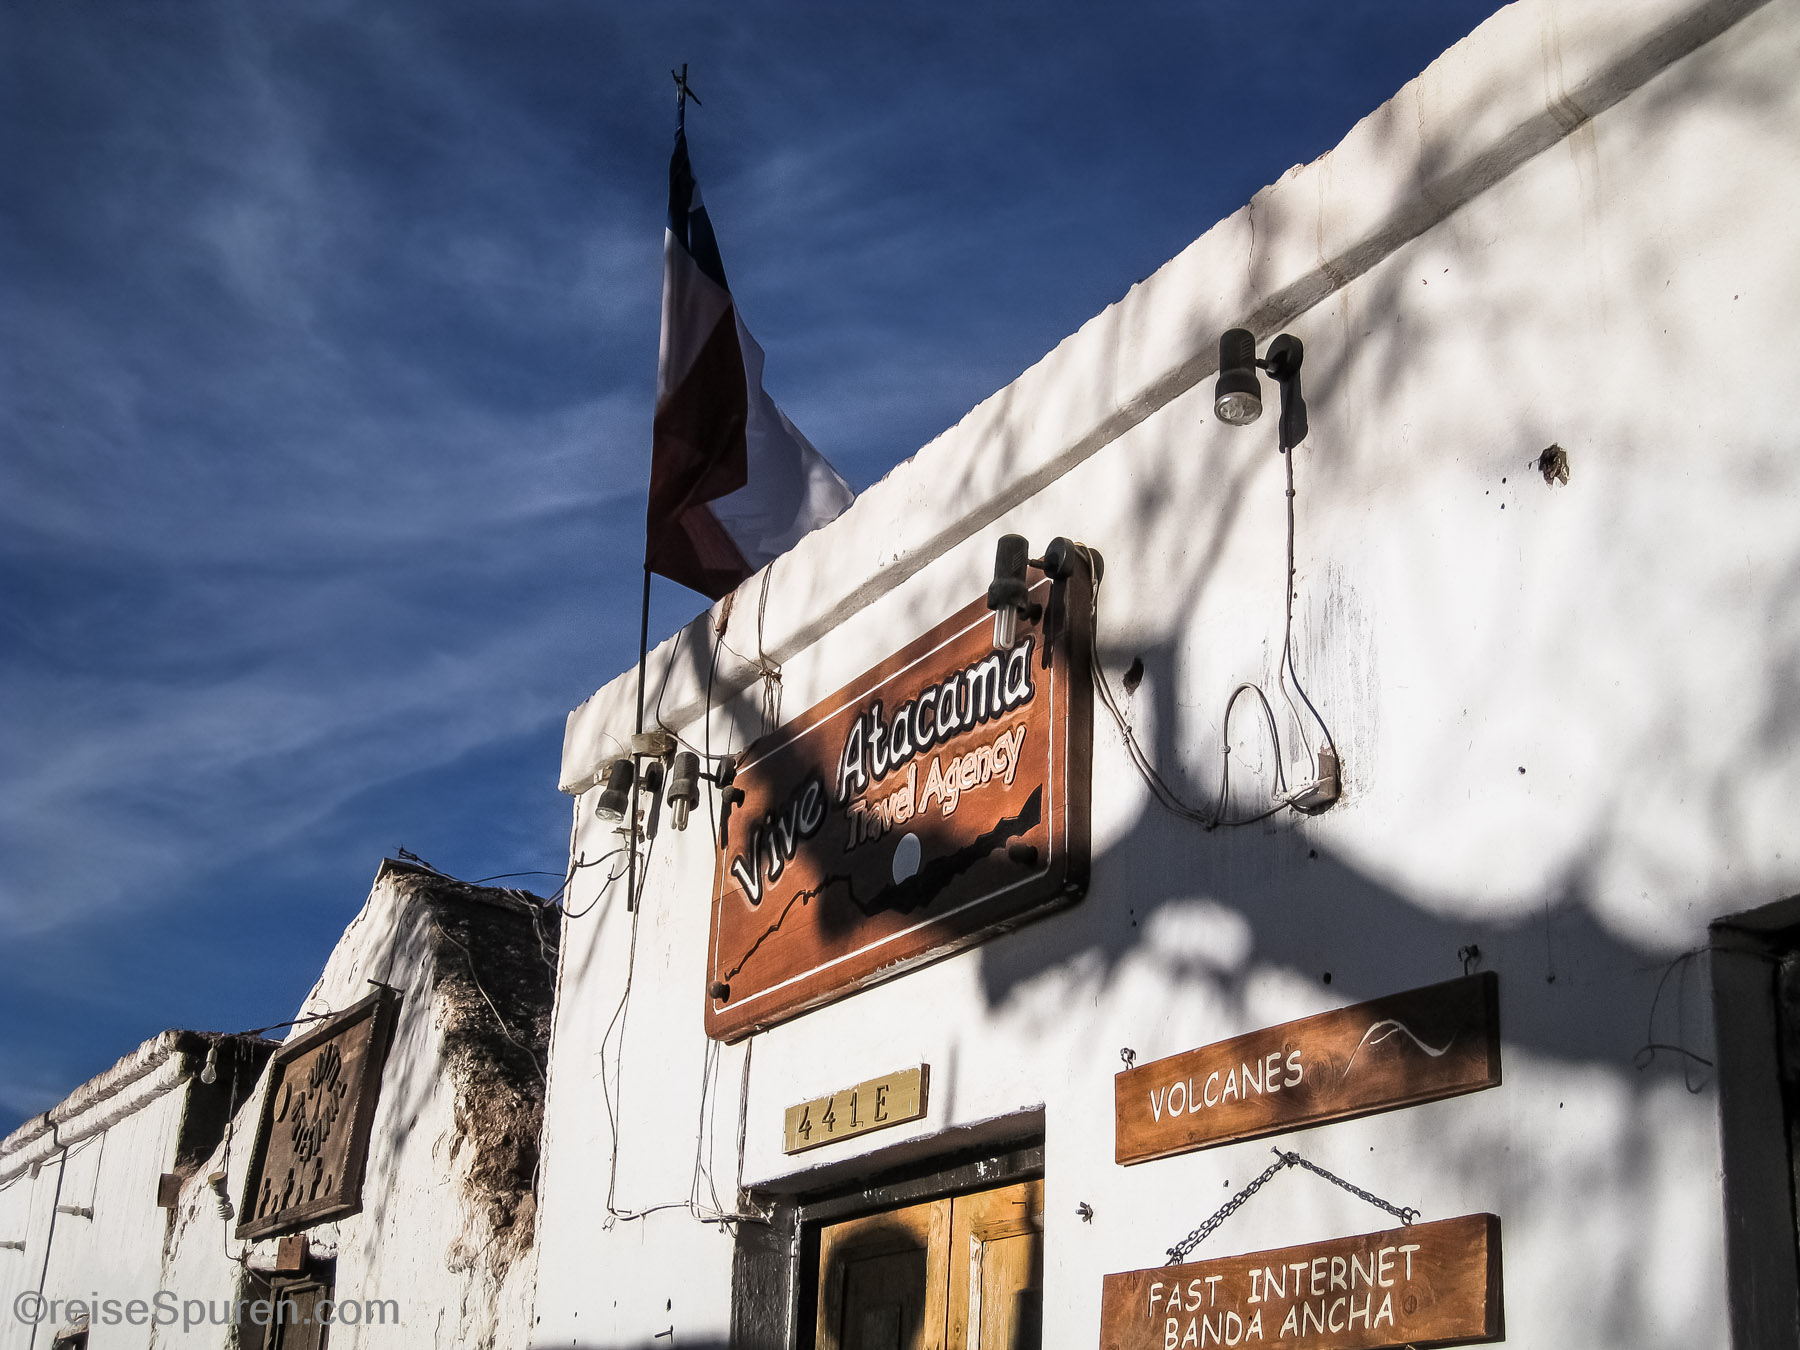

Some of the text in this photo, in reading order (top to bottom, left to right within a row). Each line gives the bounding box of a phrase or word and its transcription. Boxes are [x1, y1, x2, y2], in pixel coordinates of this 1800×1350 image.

[730, 638, 1034, 902] Vive Atacama
[846, 725, 1027, 849] Travel Agency
[1149, 1050, 1304, 1123] VOLCANES
[1148, 1244, 1421, 1317] FAST INTERNET
[1164, 1292, 1394, 1350] BANDA ANCHA
